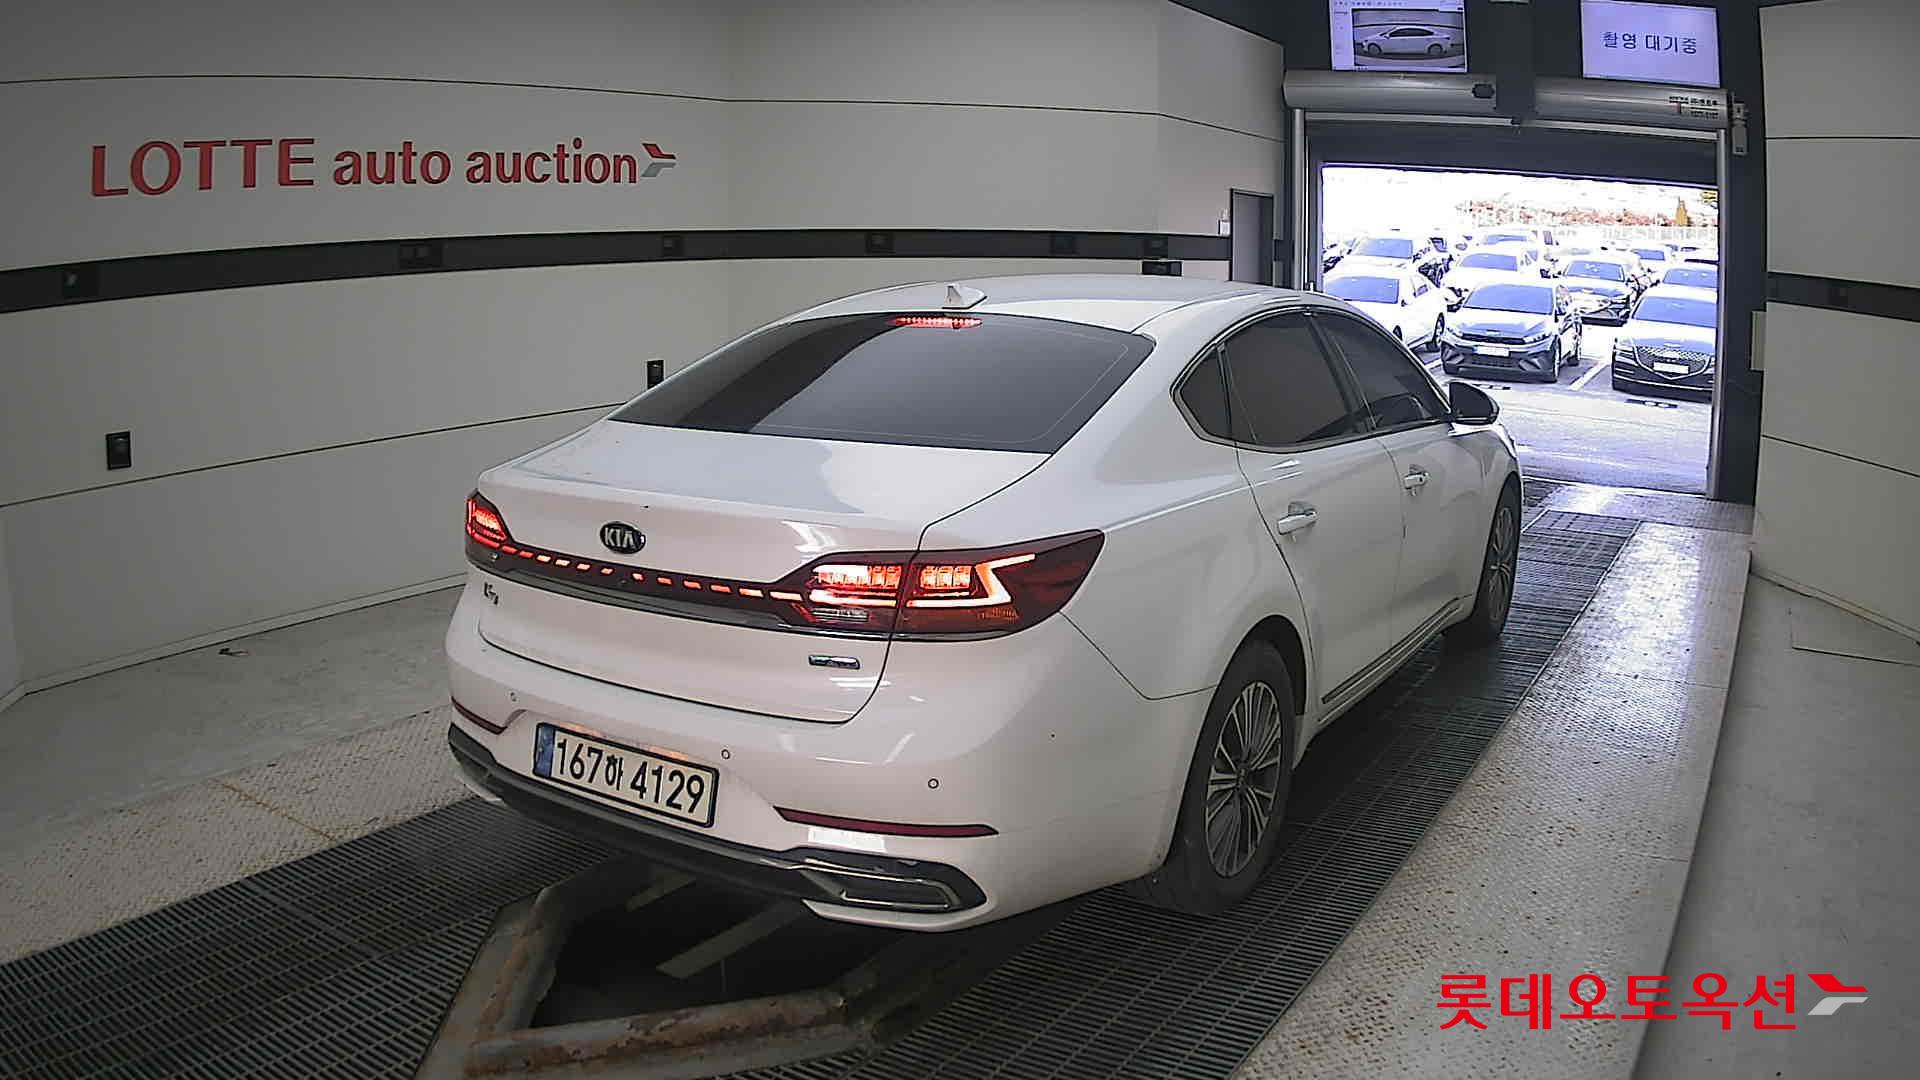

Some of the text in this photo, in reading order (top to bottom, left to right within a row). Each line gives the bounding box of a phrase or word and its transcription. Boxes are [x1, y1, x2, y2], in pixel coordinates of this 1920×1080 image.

[1645, 34, 1697, 54] 대기중
[91, 137, 638, 197] LOTTE auto auction
[604, 526, 636, 549] KIA
[557, 738, 705, 813] 167하 4129
